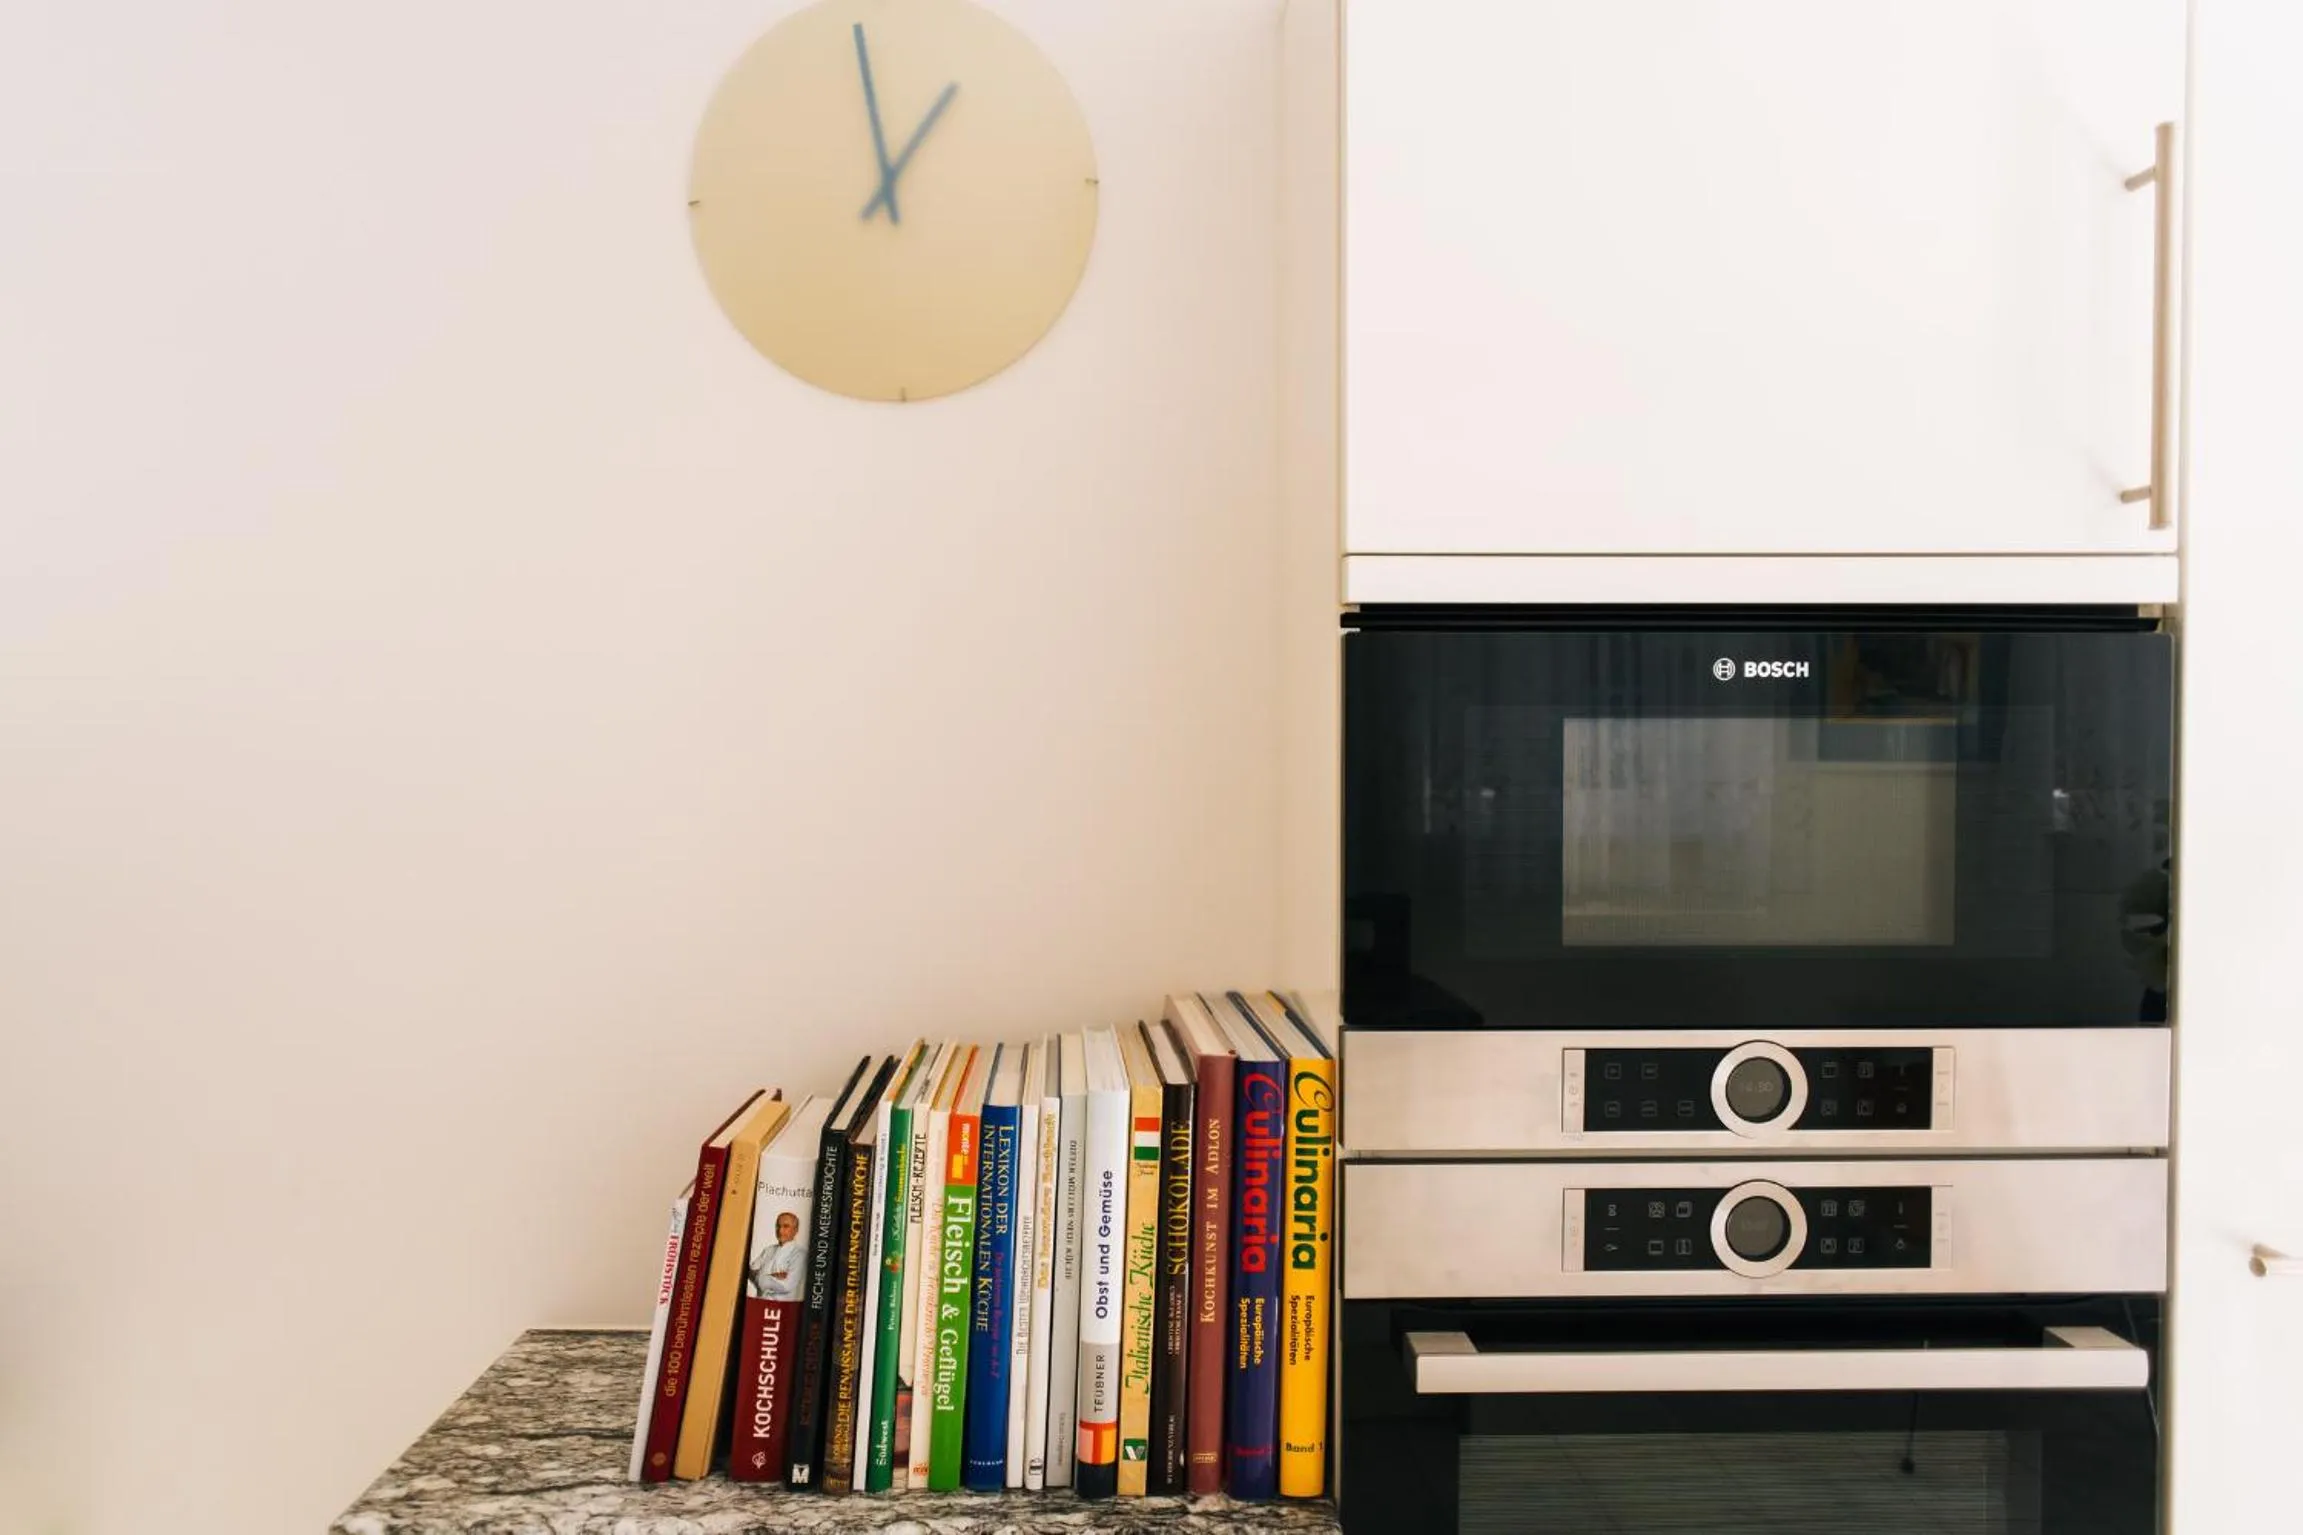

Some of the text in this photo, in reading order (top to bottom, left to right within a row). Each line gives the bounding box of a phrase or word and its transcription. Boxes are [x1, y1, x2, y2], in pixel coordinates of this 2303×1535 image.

[1744, 661, 1810, 678] BOSCH
[699, 1191, 711, 1212] der
[704, 1164, 716, 1188] welt
[758, 1181, 813, 1199] Plachutta
[853, 1153, 870, 1196] KÜCHE
[995, 1125, 1014, 1235] LEXIKON DER
[1167, 1120, 1191, 1275] SCHOKOLADE
[1241, 1072, 1284, 1274] Culinaria
[1292, 1071, 1334, 1270] Culinaria
[691, 1213, 707, 1263] rezepte
[812, 1146, 838, 1309] FISCHE UND MEERESFRÜCHTE
[847, 1197, 865, 1287] ITALIENISCHEN
[976, 1124, 996, 1332] INTERNATIONALEN KÜCHE
[1095, 1170, 1113, 1319] Obst und Gemüse
[1200, 1118, 1221, 1323] KOCHKUNST IM ADLON
[845, 1288, 859, 1314] DER
[933, 1195, 973, 1411] Fleisch & Geflügel
[1125, 1223, 1156, 1395] Italienische Küche
[1239, 1297, 1250, 1370] Spezialitäten
[1252, 1297, 1265, 1365] Europäische
[1289, 1295, 1301, 1366] Spezialitäten
[1302, 1295, 1315, 1361] Europäische
[665, 1377, 678, 1397] die
[668, 1351, 682, 1374] 100
[753, 1308, 781, 1438] KOCHSCHULE
[840, 1315, 857, 1400] RENAISSANCE
[1094, 1355, 1106, 1413] TEUBNER
[838, 1400, 851, 1422] DIE
[876, 1420, 890, 1466] Südwest
[1286, 1442, 1315, 1453] Band
